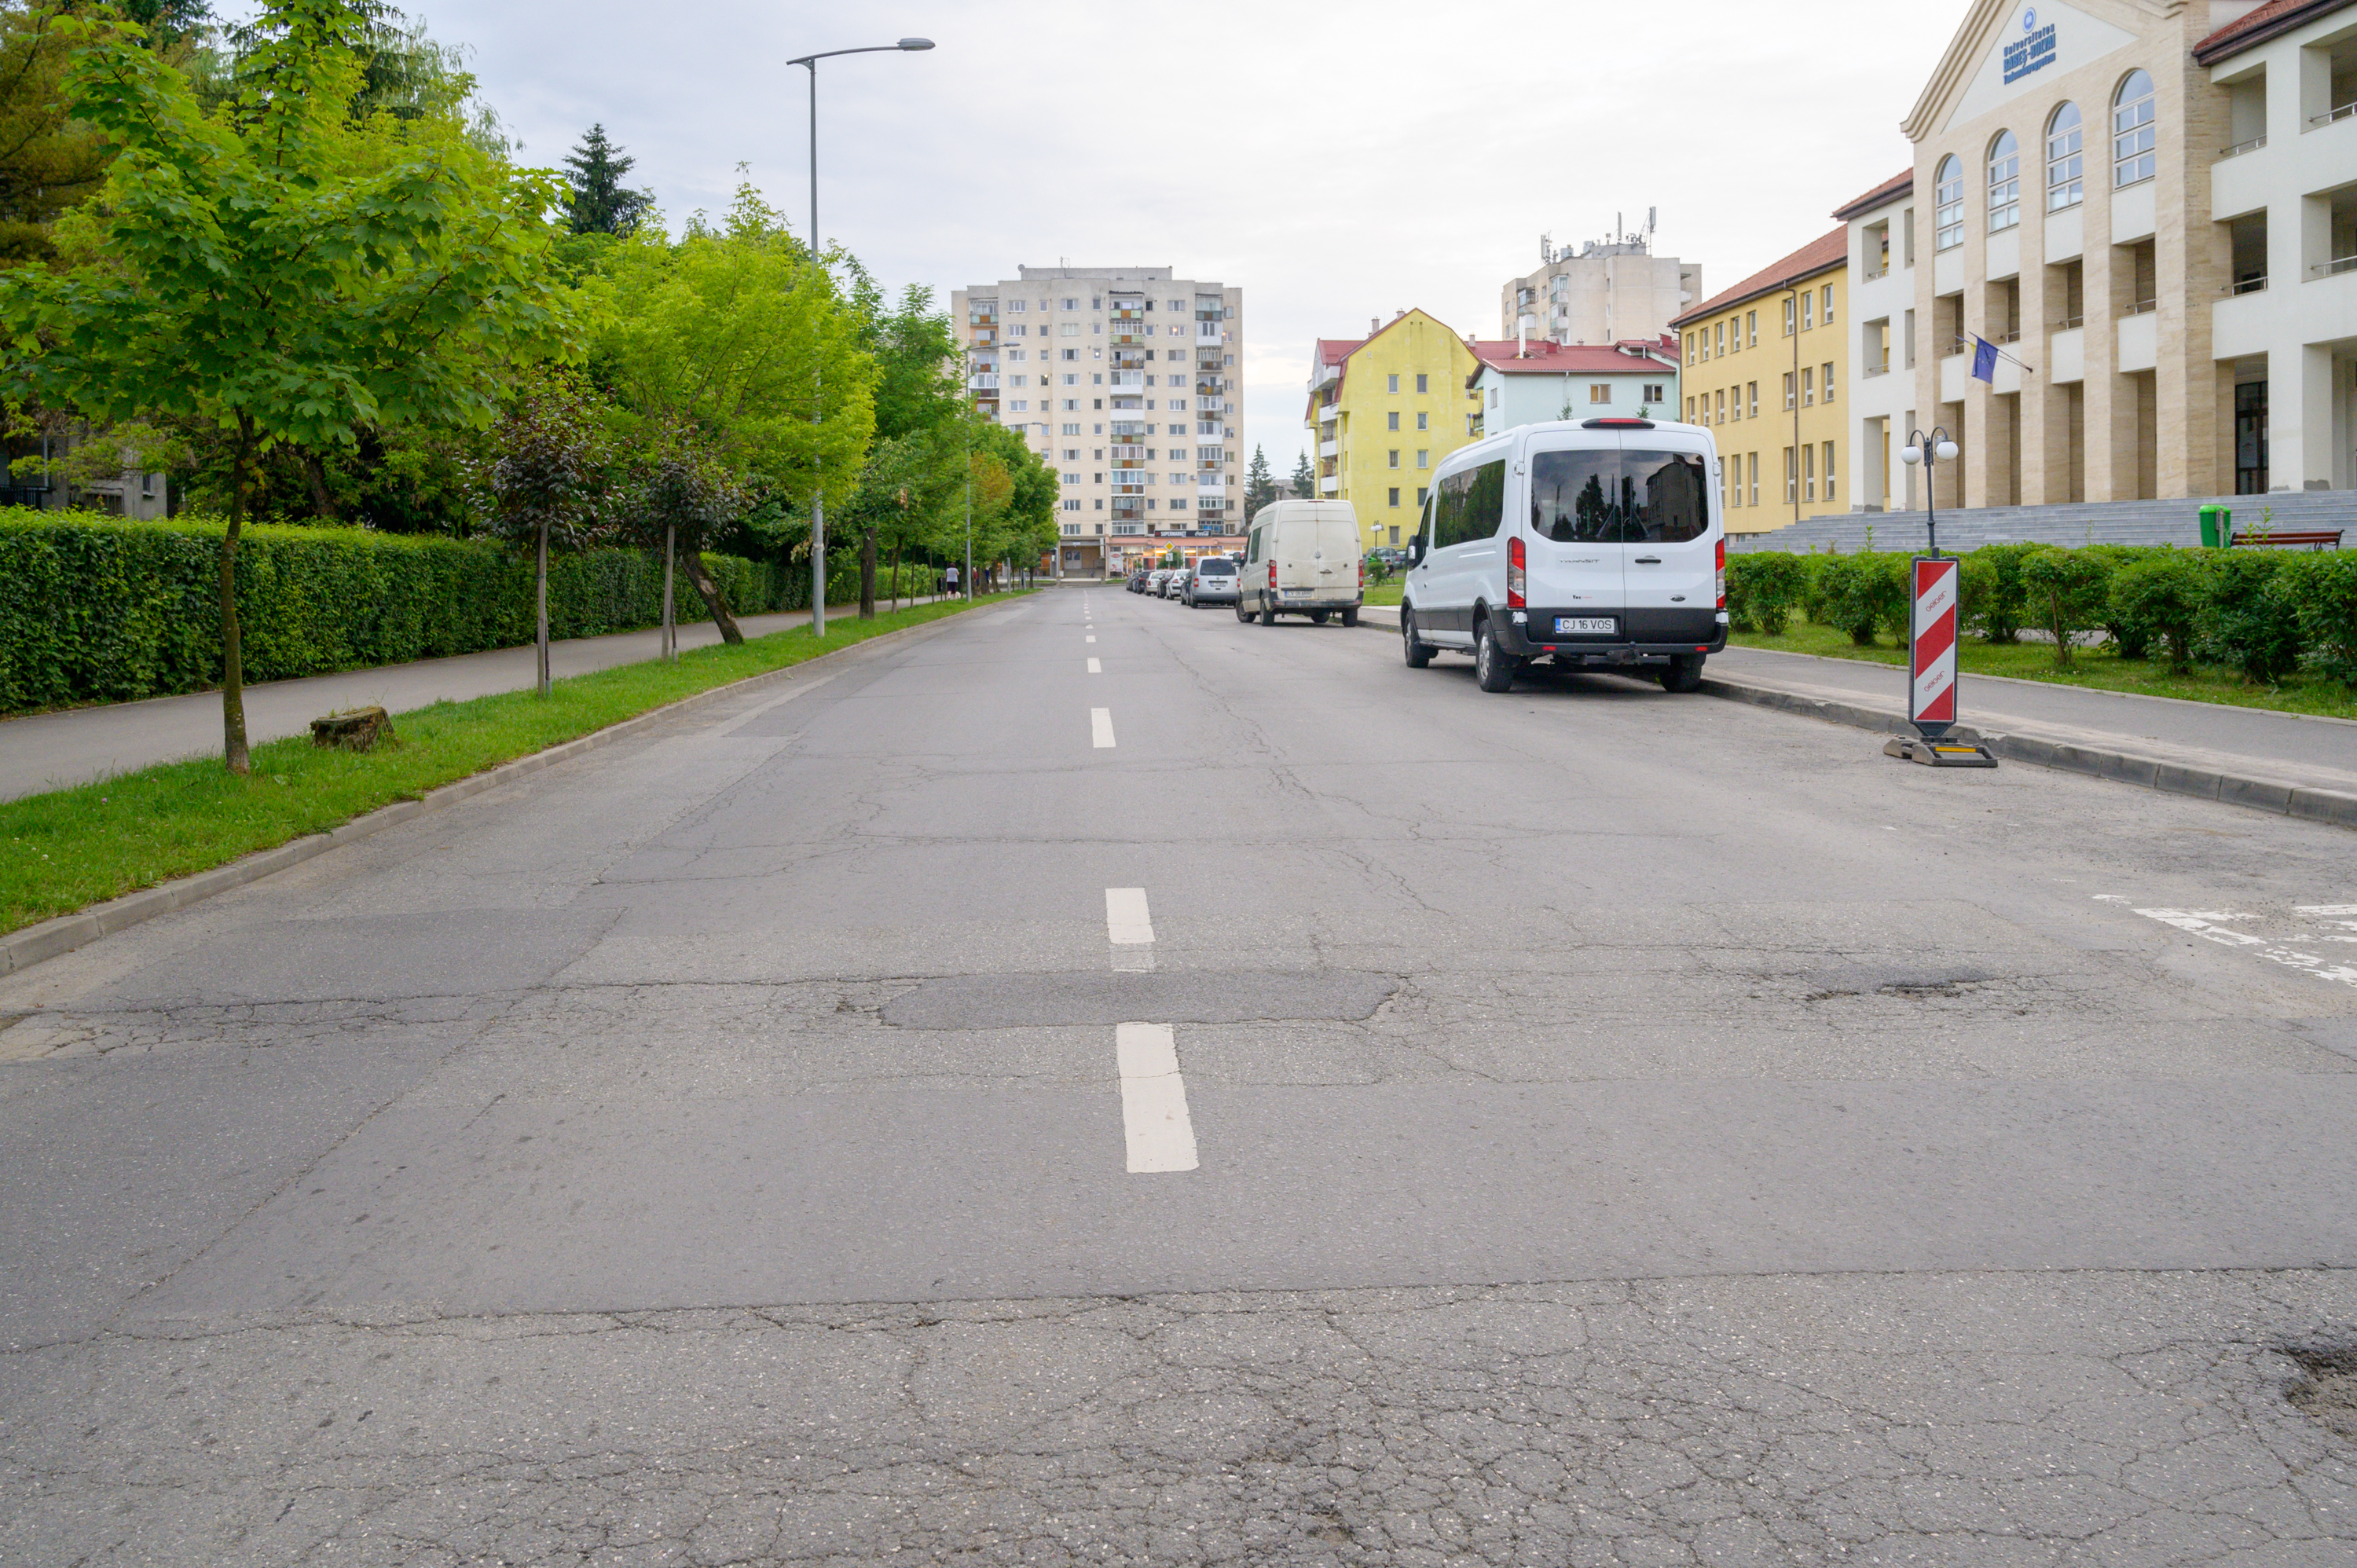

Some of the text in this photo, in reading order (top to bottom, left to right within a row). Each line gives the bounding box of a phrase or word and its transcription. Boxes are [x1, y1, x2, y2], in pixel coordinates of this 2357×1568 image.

[2003, 24, 2055, 57] Universitatea
[1563, 620, 1612, 629] CJ 16 VOS
